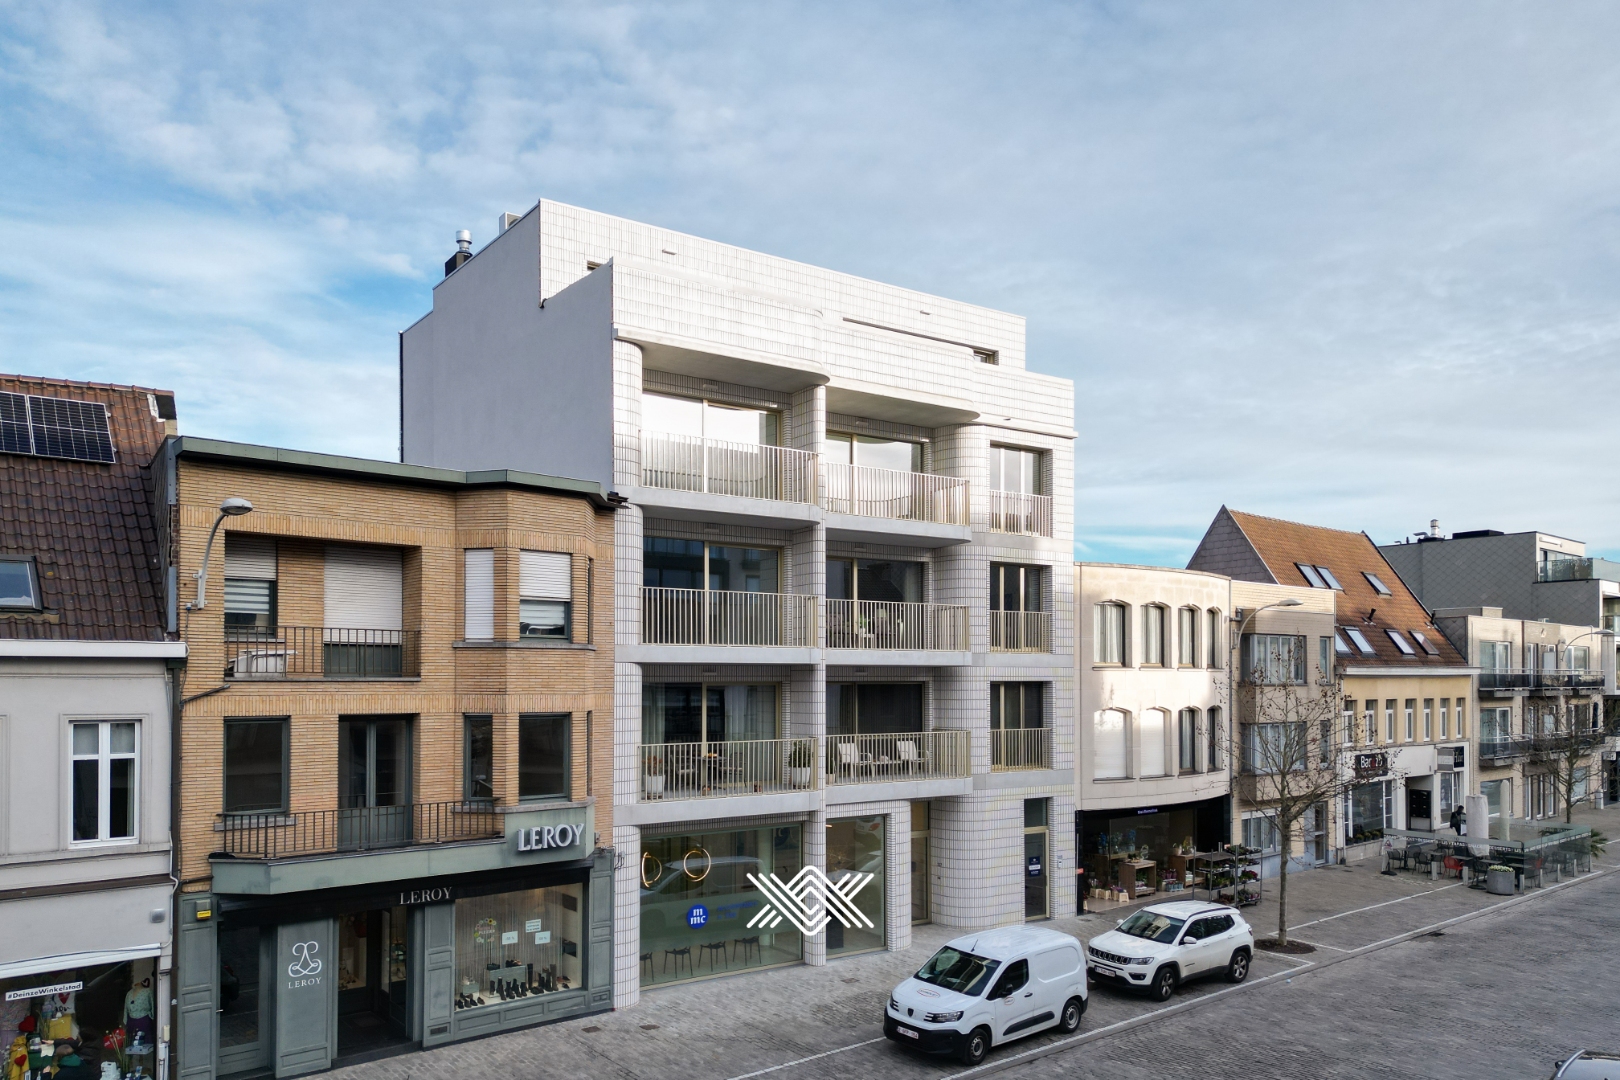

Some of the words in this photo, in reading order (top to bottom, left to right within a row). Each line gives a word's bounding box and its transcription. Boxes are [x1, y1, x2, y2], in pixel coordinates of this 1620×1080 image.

[518, 823, 584, 851] LEROY
[400, 886, 452, 905] LEROY
[693, 908, 703, 917] m
[690, 916, 706, 925] mc
[288, 976, 322, 989] LEROY
[7, 983, 81, 999] #DeinzeWinkelstad
